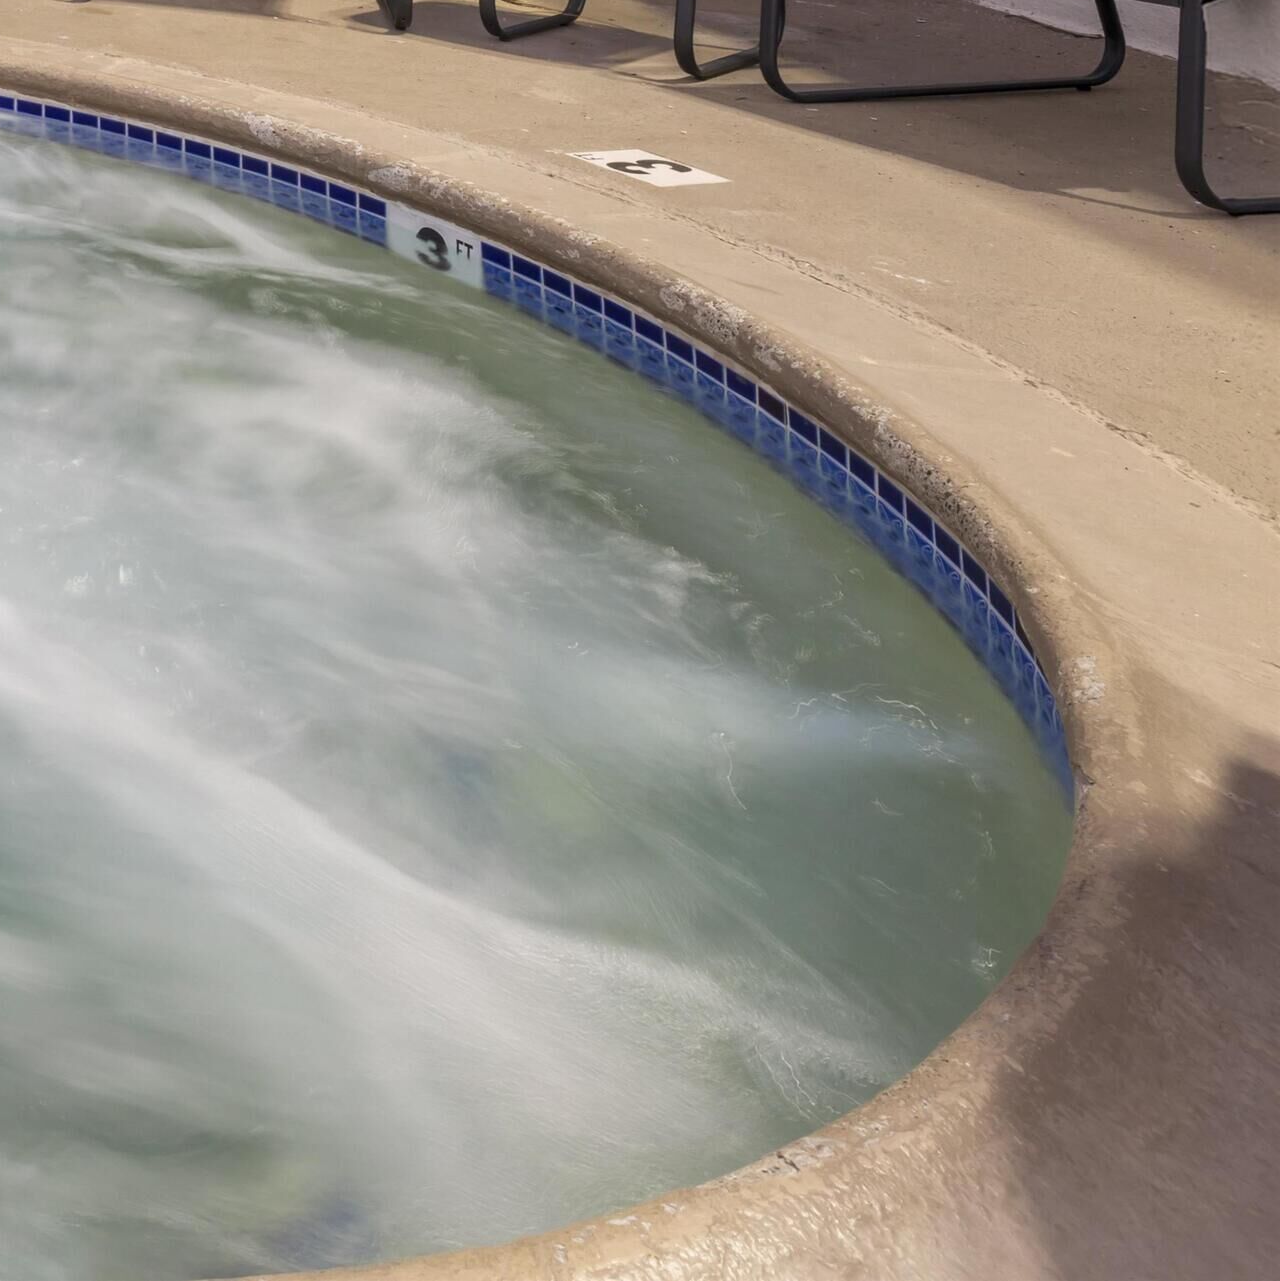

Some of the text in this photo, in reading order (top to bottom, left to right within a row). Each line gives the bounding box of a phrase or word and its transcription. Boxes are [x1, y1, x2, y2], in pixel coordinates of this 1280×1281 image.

[606, 159, 693, 175] 3
[416, 226, 473, 271] 3 FT
